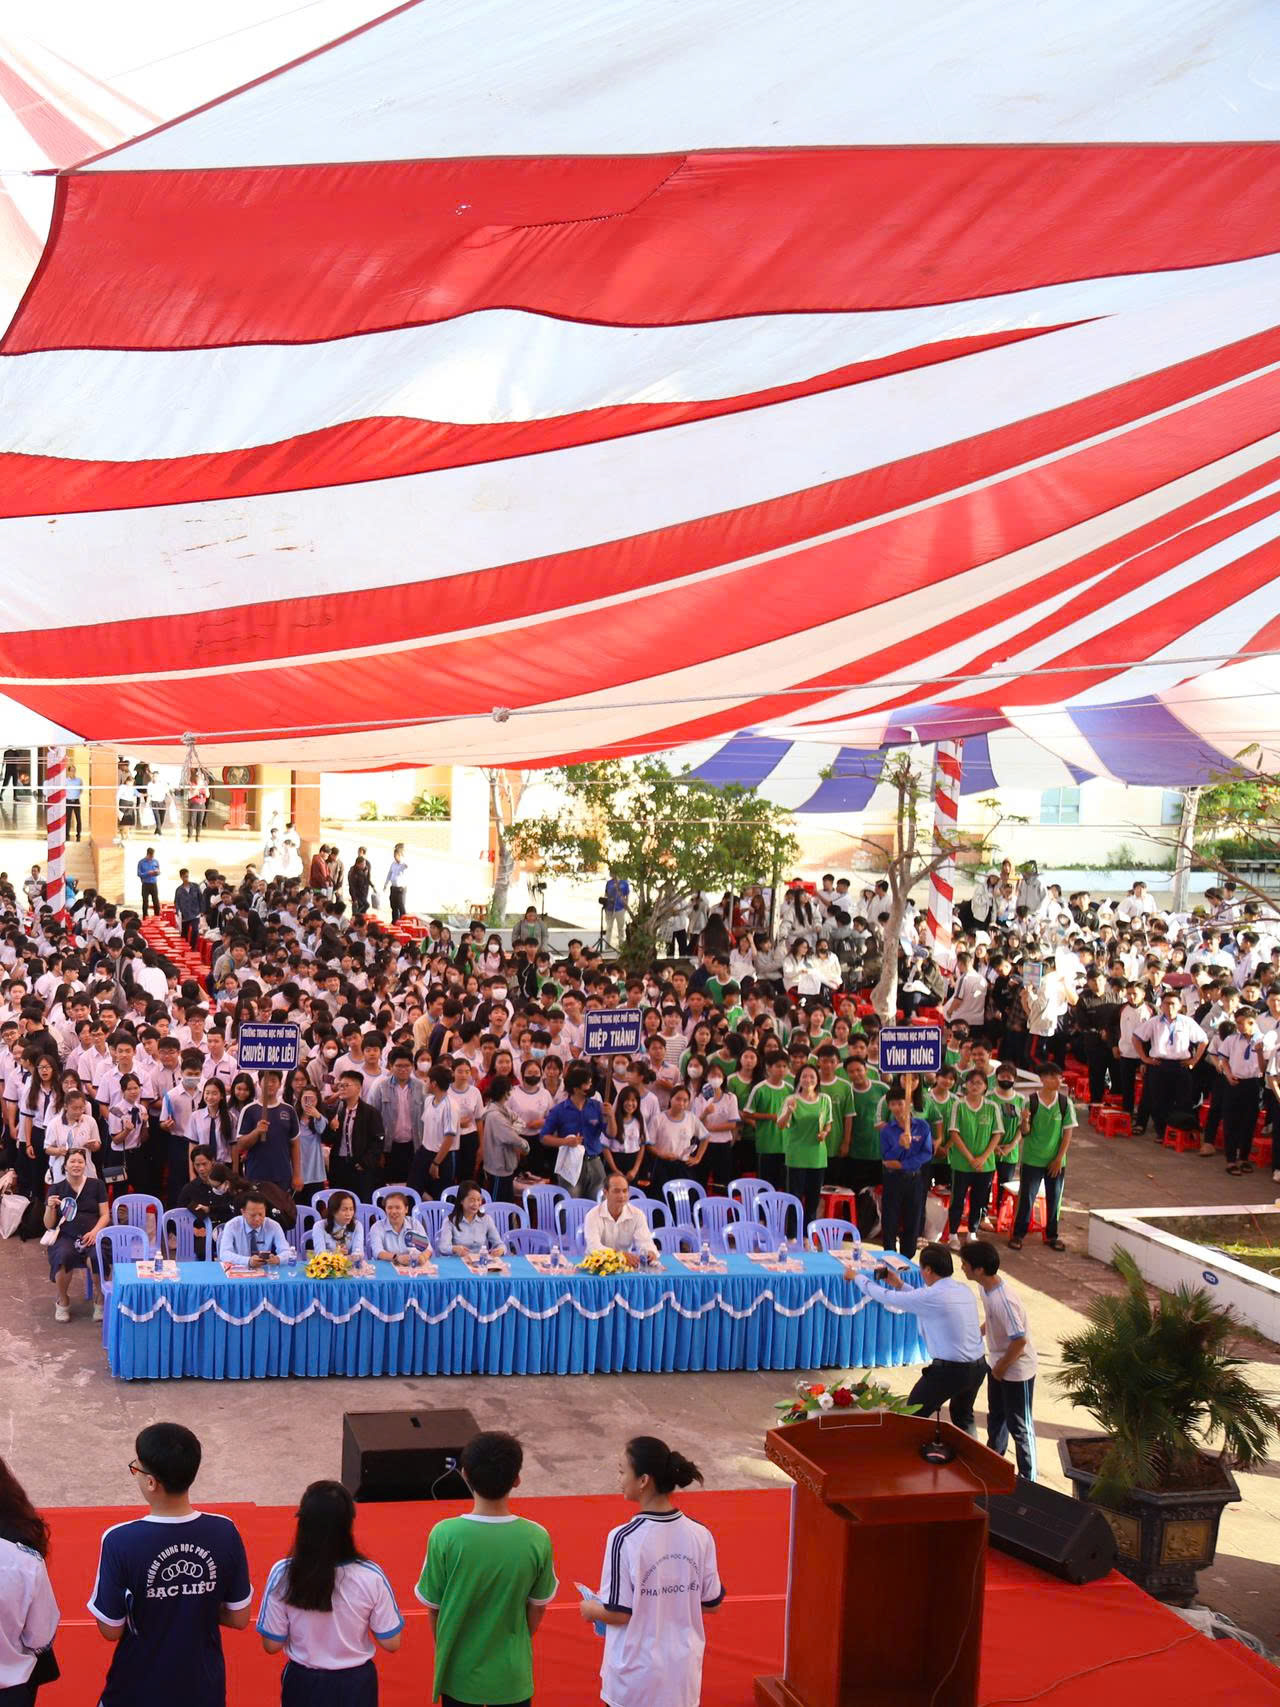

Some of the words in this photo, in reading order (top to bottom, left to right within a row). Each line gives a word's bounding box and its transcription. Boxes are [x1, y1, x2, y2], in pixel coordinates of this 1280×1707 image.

[589, 1028, 608, 1050] HIỆP
[610, 1027, 636, 1047] THÀNH
[242, 1042, 265, 1062] CHUYÊN
[268, 1046, 280, 1065] BẠC
[281, 1043, 295, 1062] LIÊU
[886, 1046, 907, 1066] VĨNH
[146, 1560, 161, 1587] TRƯỜNG
[157, 1544, 179, 1561] TRUNG
[180, 1543, 194, 1553] HỌC
[194, 1546, 211, 1559] PHỔ
[206, 1557, 217, 1580] THÔNG
[146, 1585, 179, 1600] BẠC
[182, 1580, 217, 1595] LIÊU
